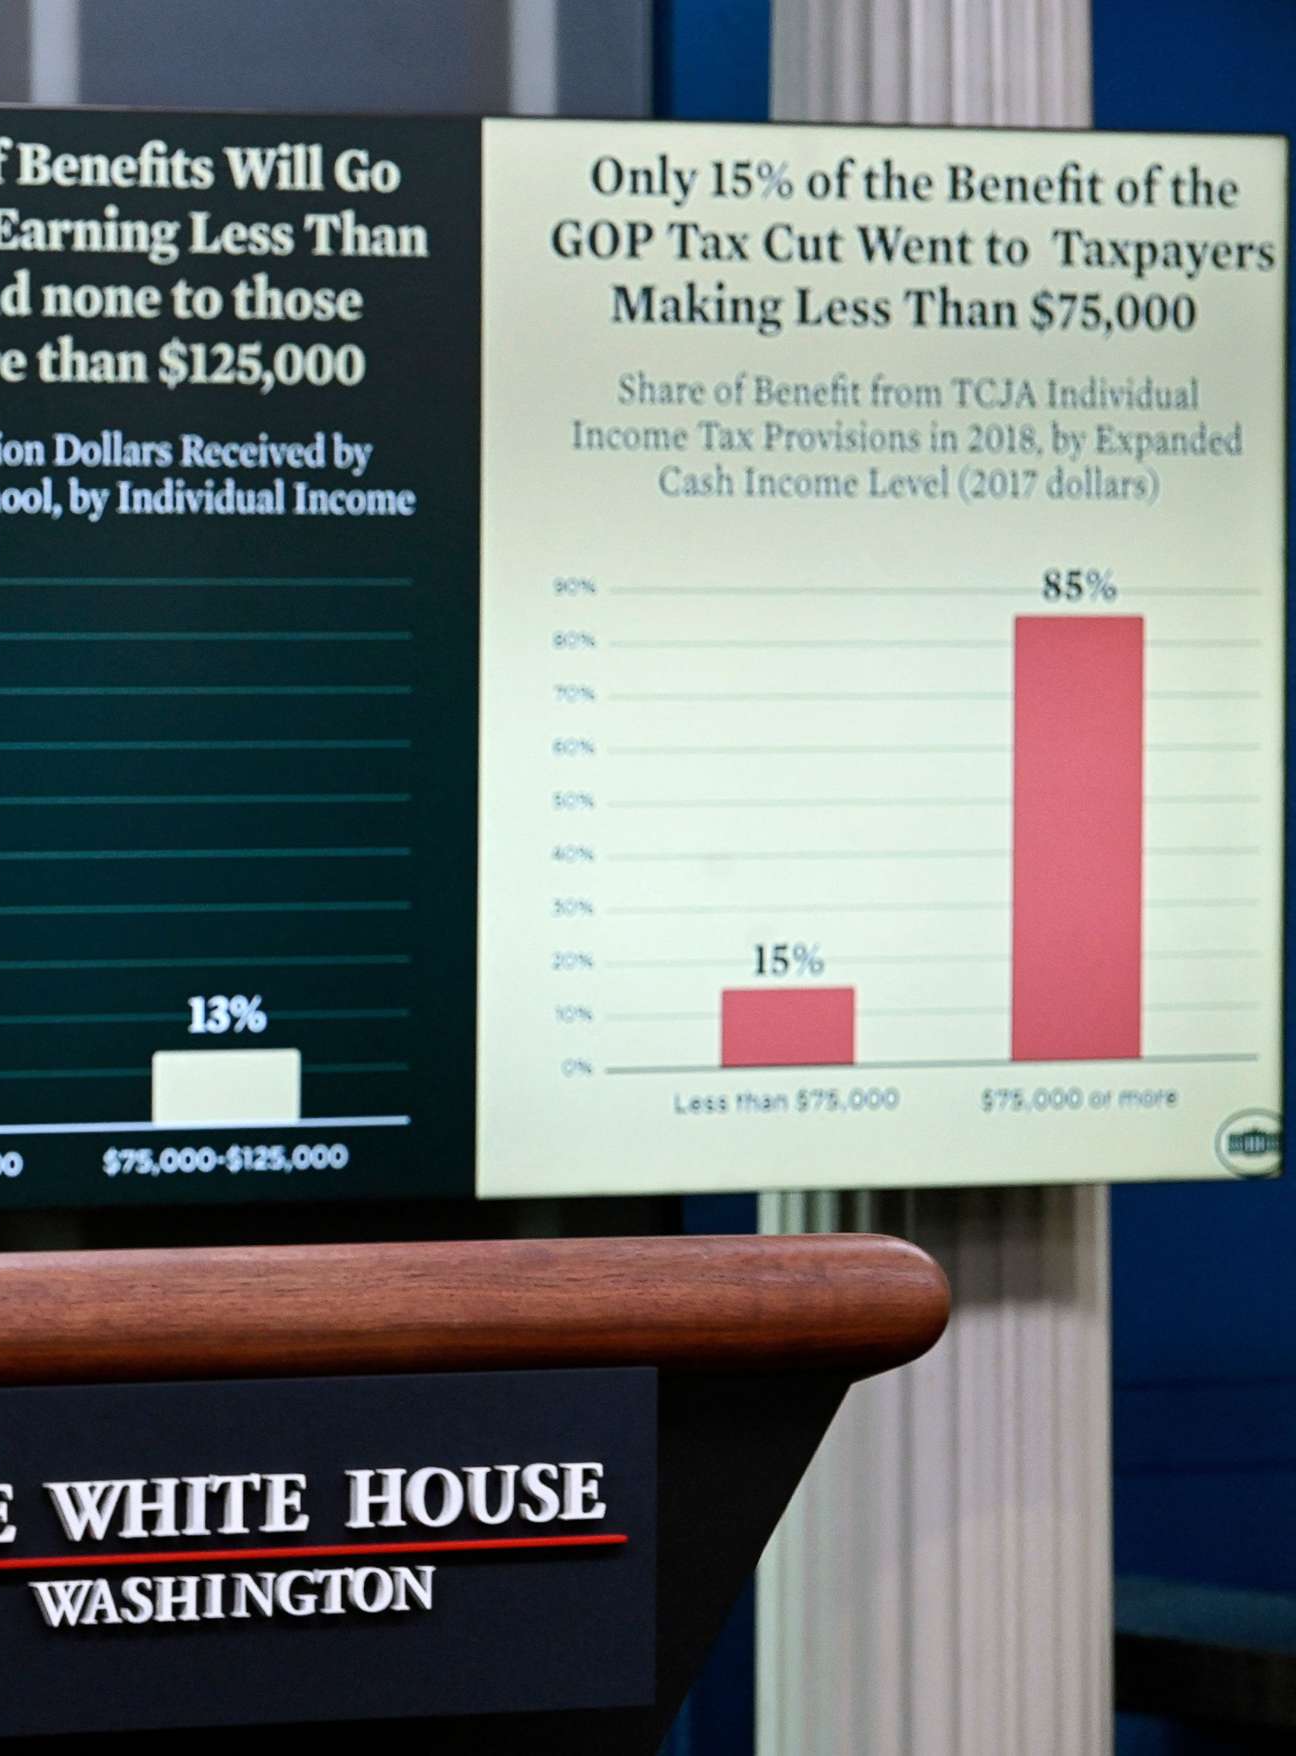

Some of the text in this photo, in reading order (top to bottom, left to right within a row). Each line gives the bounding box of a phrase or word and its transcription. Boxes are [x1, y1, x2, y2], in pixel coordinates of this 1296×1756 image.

[16, 140, 214, 189] Benefits
[224, 143, 323, 190] Will
[335, 149, 400, 192] Go
[592, 154, 1238, 207] Only 15% of the Benefit of the
[190, 212, 294, 255] Less
[304, 210, 427, 257] Than
[552, 221, 1275, 279] GOP Tax Cut Went to Taxpayers
[42, 285, 161, 318] none
[172, 280, 222, 319] to
[233, 272, 363, 320] those
[614, 282, 1196, 337] Making Less Than $75,000
[37, 335, 147, 382] than
[159, 338, 365, 393] $125,000
[618, 371, 1198, 410] Share of Benefit from TCJA Individual
[54, 430, 172, 467] Dollars
[181, 432, 325, 468] Received
[333, 432, 372, 476] by
[573, 420, 1242, 462] Income Tax Provisions in 2018, by Expanded
[69, 477, 109, 522] by
[118, 478, 284, 514] Individual
[294, 482, 415, 515] Income
[659, 463, 1159, 501] Cash Income Level (2017 dollars)
[1043, 570, 1117, 600] 85%
[756, 944, 824, 976] 15%
[189, 995, 267, 1033] 13%
[674, 1087, 900, 1114] Less than $75,000
[982, 1087, 1178, 1113] $75,000 or more
[103, 1144, 348, 1176] $75,000-$125,000
[44, 1473, 309, 1541] WHITE
[346, 1462, 606, 1528] HOUSE
[30, 1566, 435, 1627] WASHINGTON
